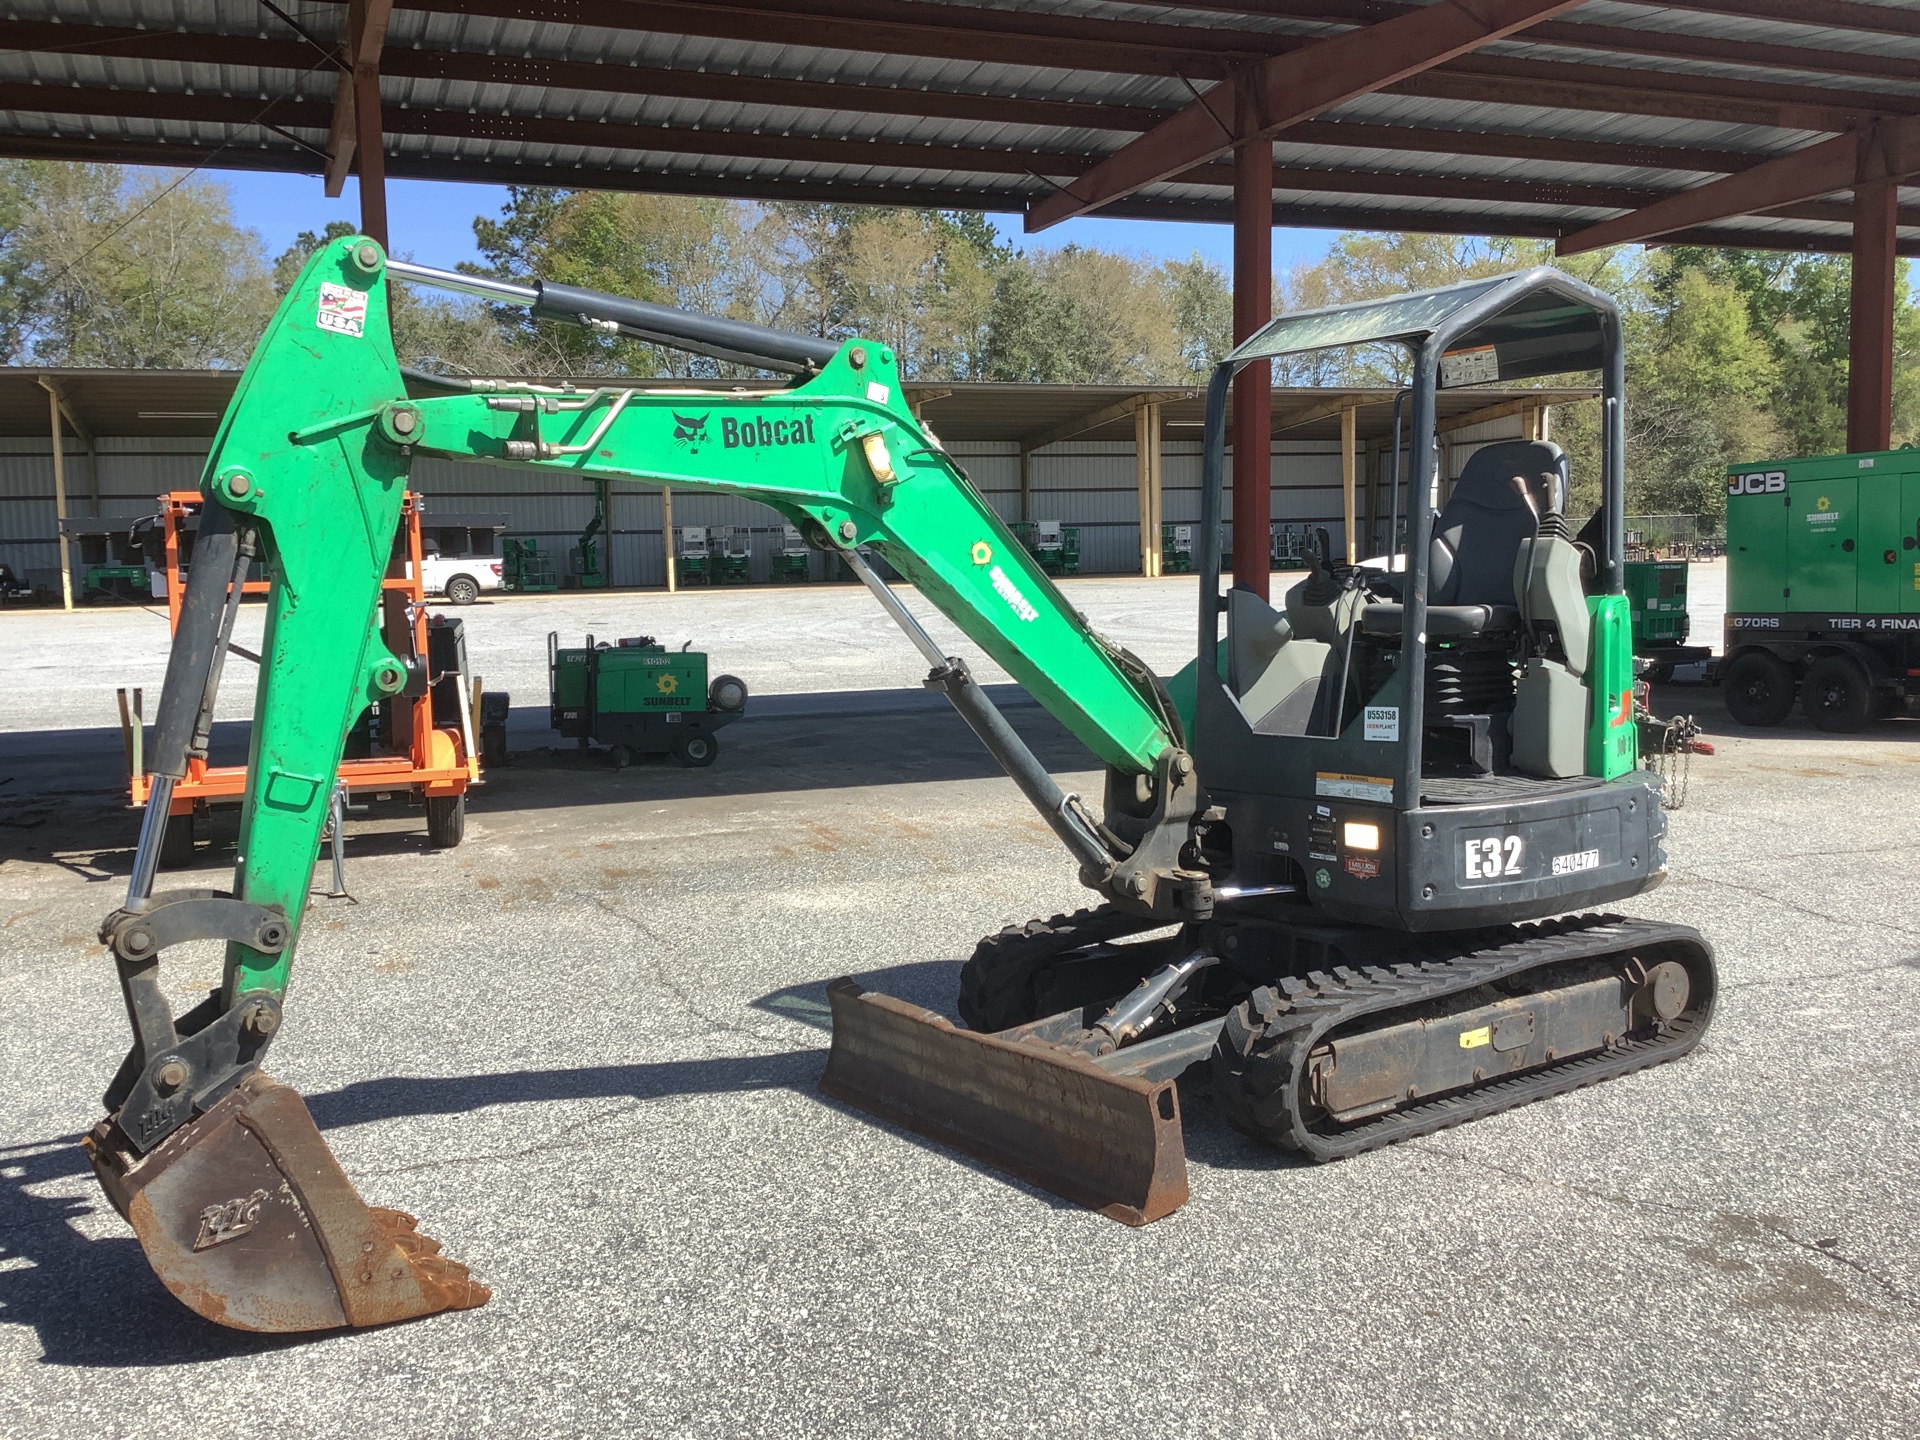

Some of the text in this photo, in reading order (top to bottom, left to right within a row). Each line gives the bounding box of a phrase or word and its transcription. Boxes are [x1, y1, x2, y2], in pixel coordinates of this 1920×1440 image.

[319, 312, 361, 333] USA
[720, 413, 816, 449] Bobcat
[1728, 472, 1785, 495] JCB
[1806, 511, 1840, 522] SUNBELT
[1733, 617, 1780, 628] G70RS
[1828, 618, 1920, 630] TIER 4 FINA
[643, 696, 692, 706] SUNBELT
[1367, 710, 1397, 720] U553158
[1465, 835, 1522, 879] E32
[1552, 850, 1598, 874] 640477
